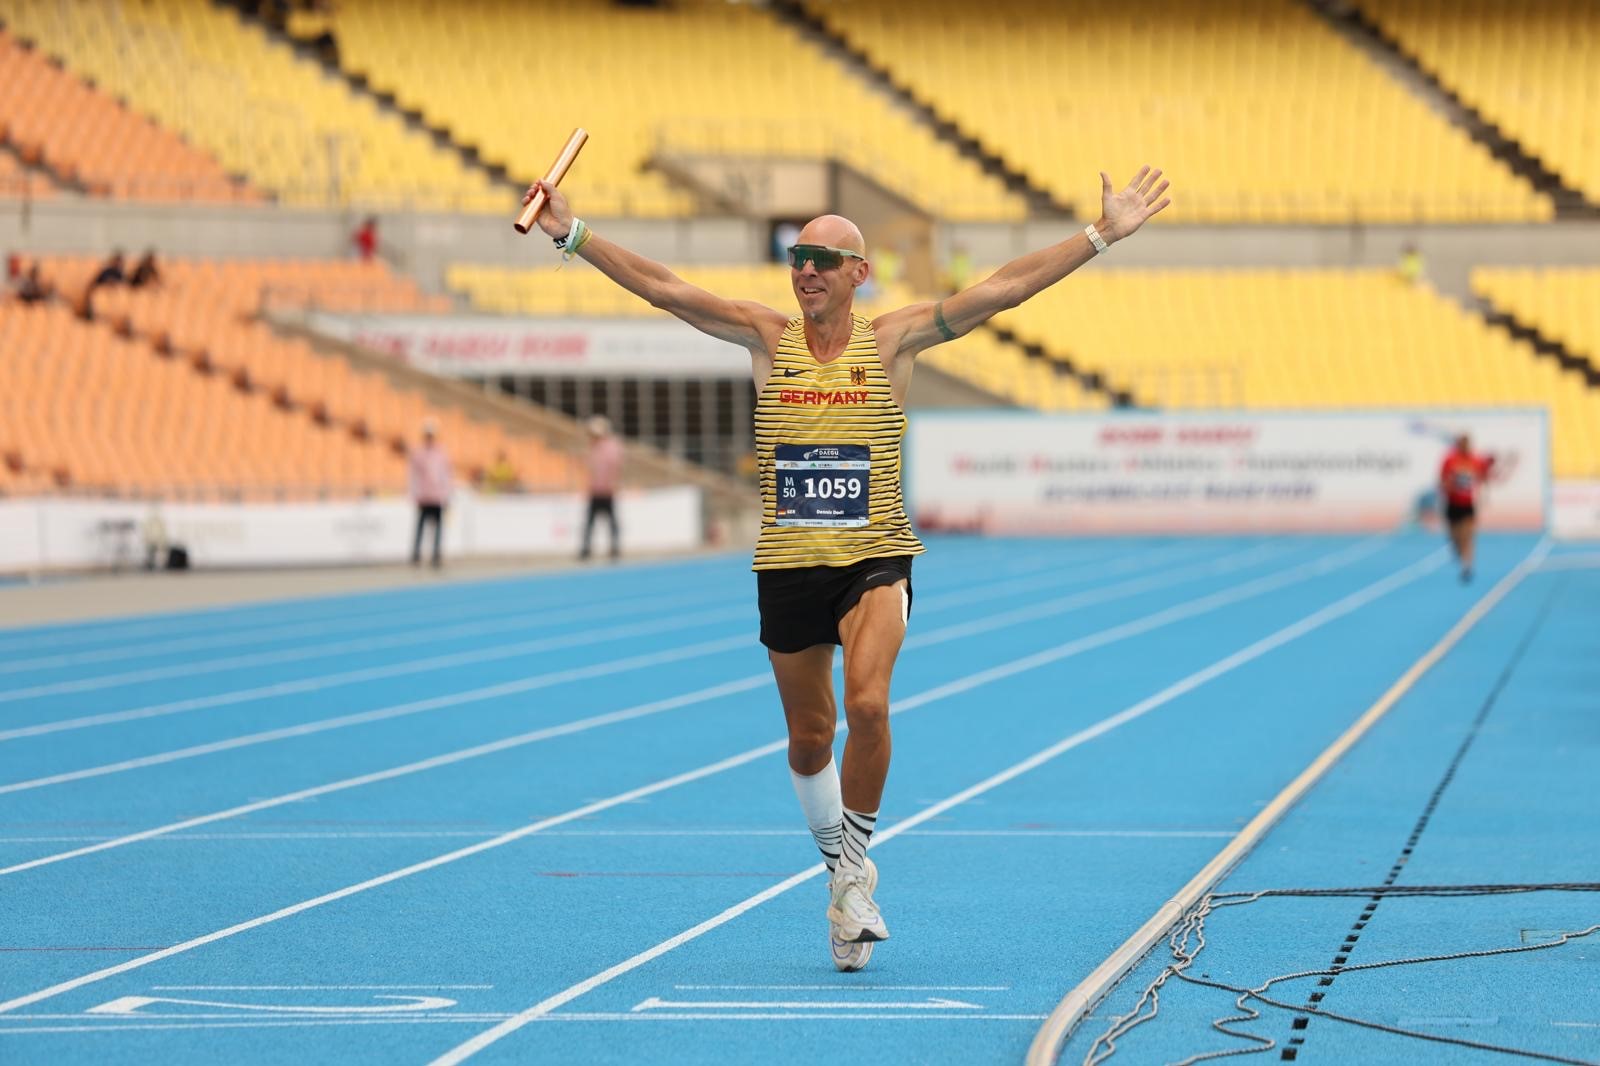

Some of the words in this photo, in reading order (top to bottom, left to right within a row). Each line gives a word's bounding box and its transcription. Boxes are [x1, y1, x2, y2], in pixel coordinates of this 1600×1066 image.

[779, 389, 870, 405] GERMANY
[785, 476, 795, 486] M
[783, 487, 796, 498] 50
[804, 477, 862, 499] 1059
